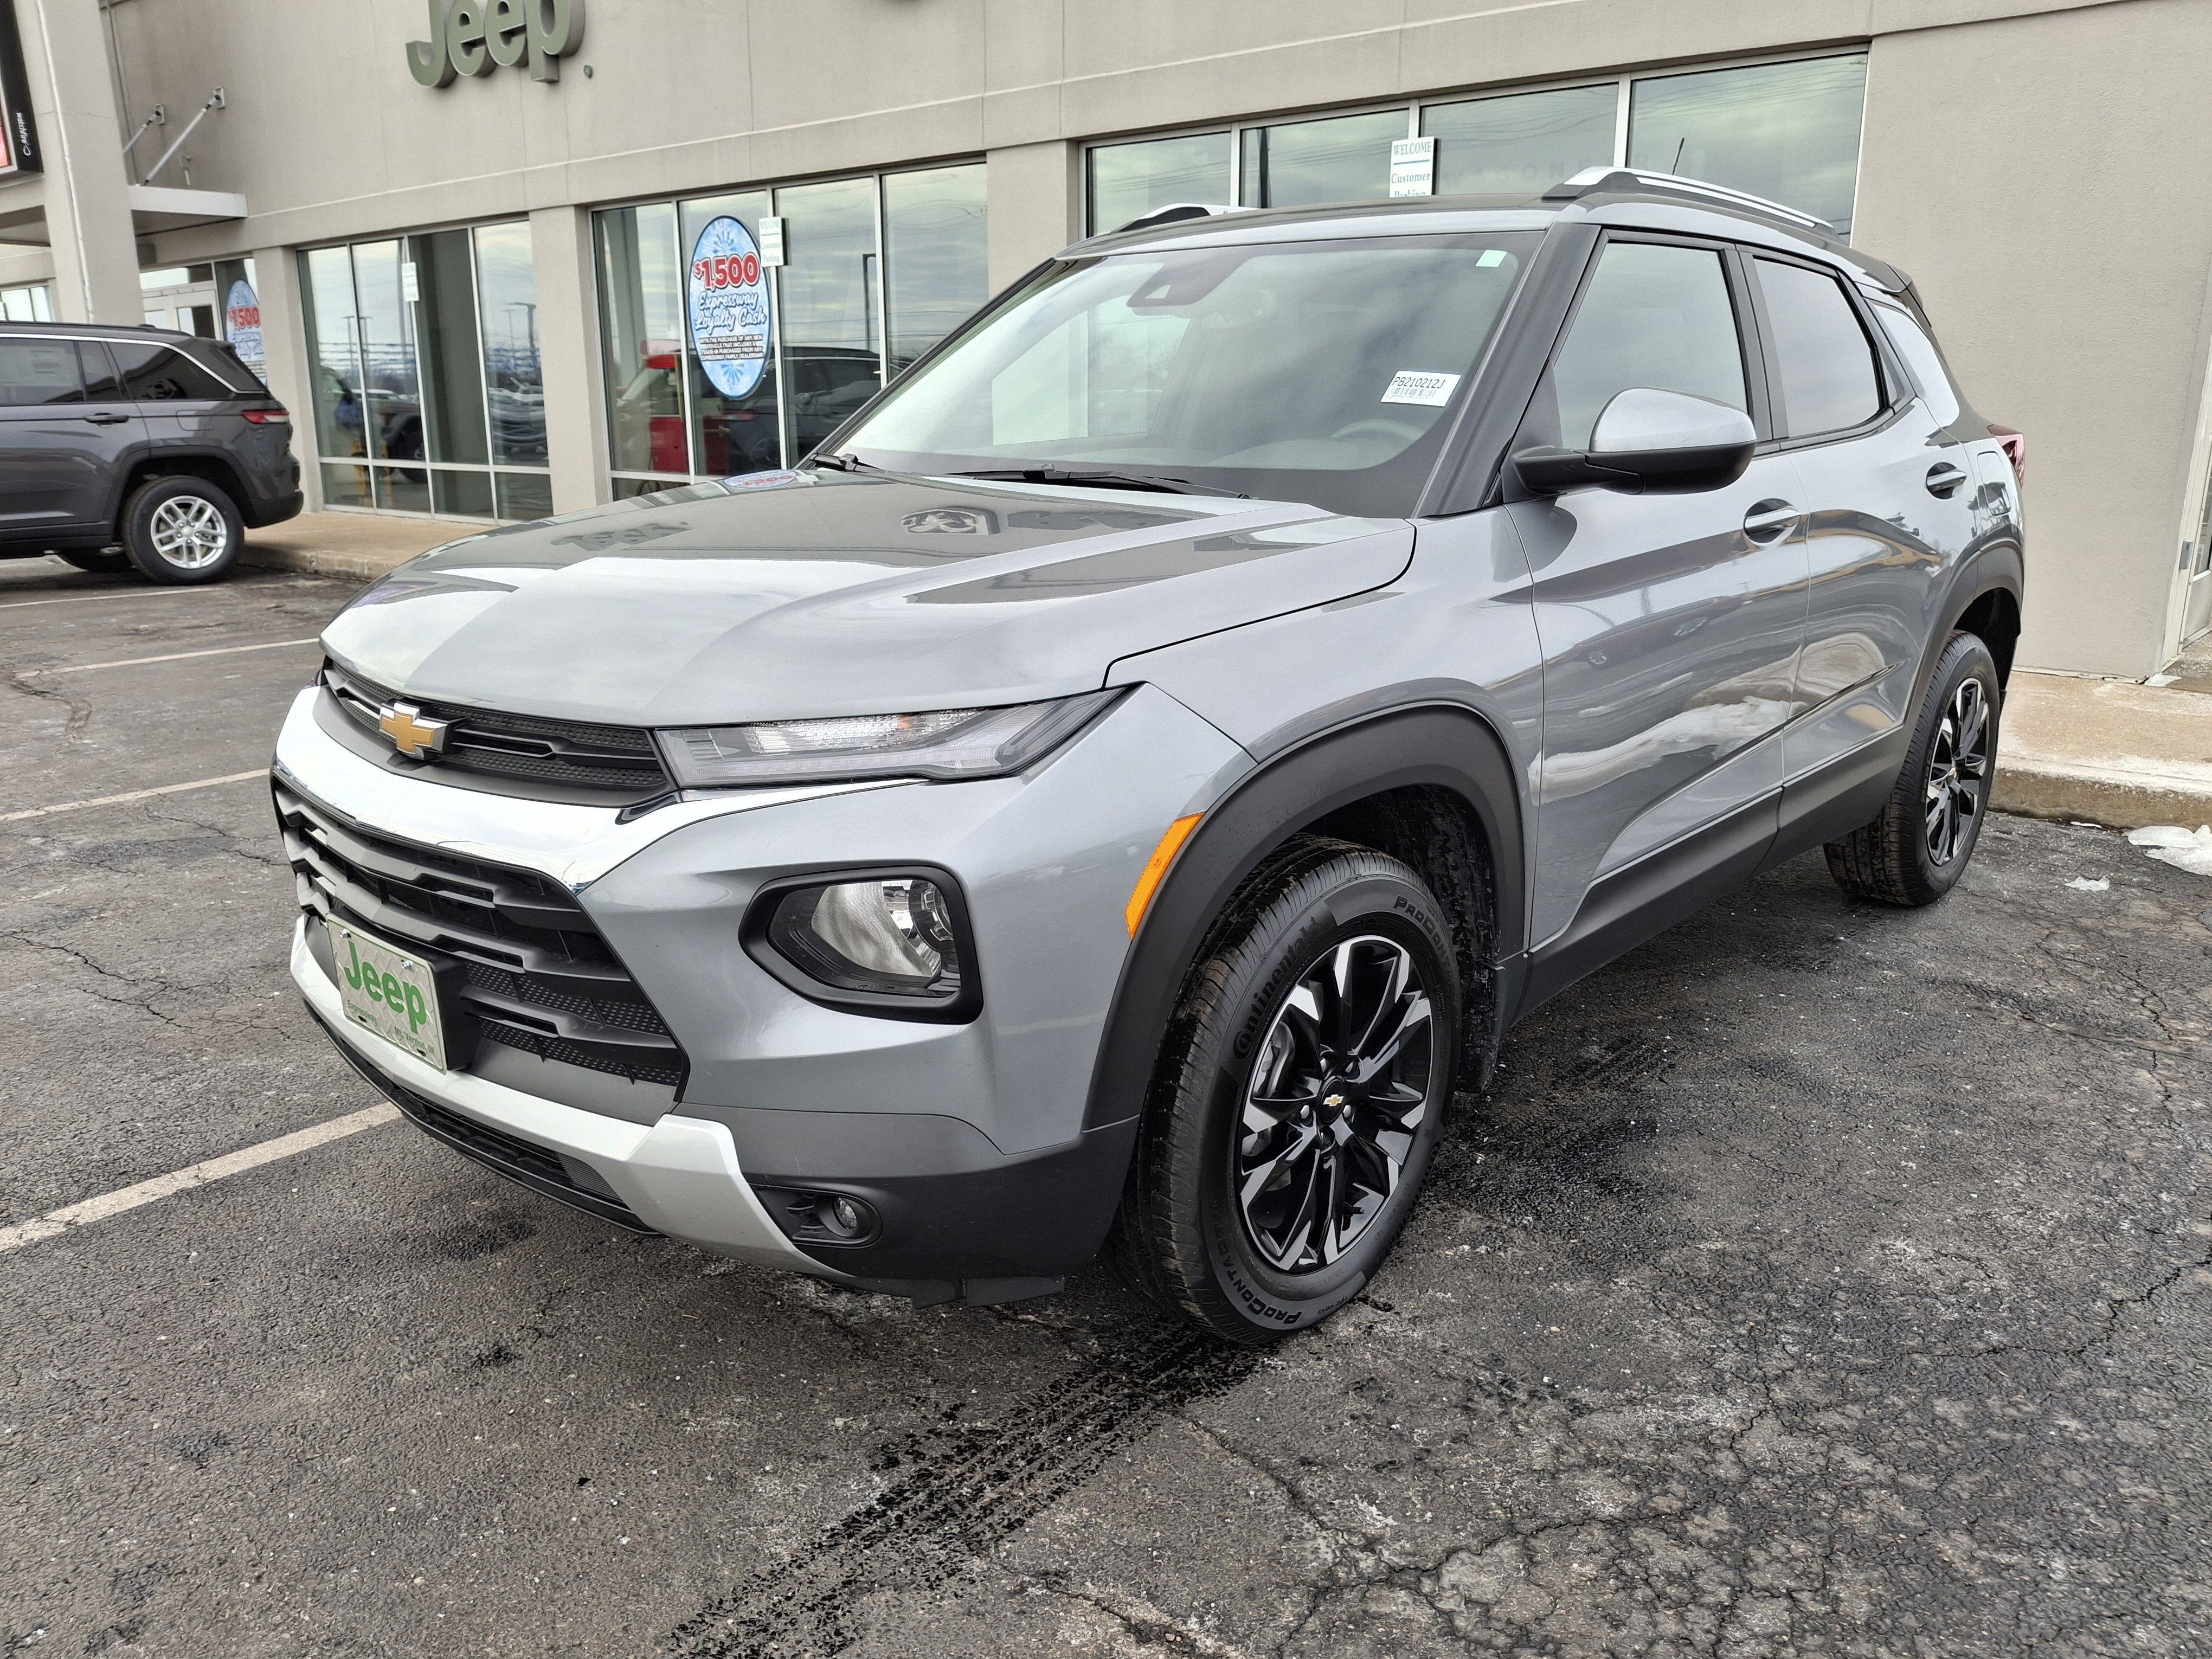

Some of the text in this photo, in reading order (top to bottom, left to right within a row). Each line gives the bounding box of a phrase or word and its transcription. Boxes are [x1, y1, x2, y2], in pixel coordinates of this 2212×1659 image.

[405, 0, 584, 88] Jeep
[1393, 142, 1431, 155] WELCOME
[1391, 173, 1431, 184] Customer
[760, 220, 780, 229] WELCOME
[763, 254, 780, 263] Parking
[693, 252, 760, 292] $1,500
[697, 291, 758, 316] Expressway
[694, 305, 767, 335] Loyalty Cash
[1392, 376, 1445, 389] PB210212J
[344, 940, 427, 1034] Jeep
[347, 999, 377, 1026] Expressway
